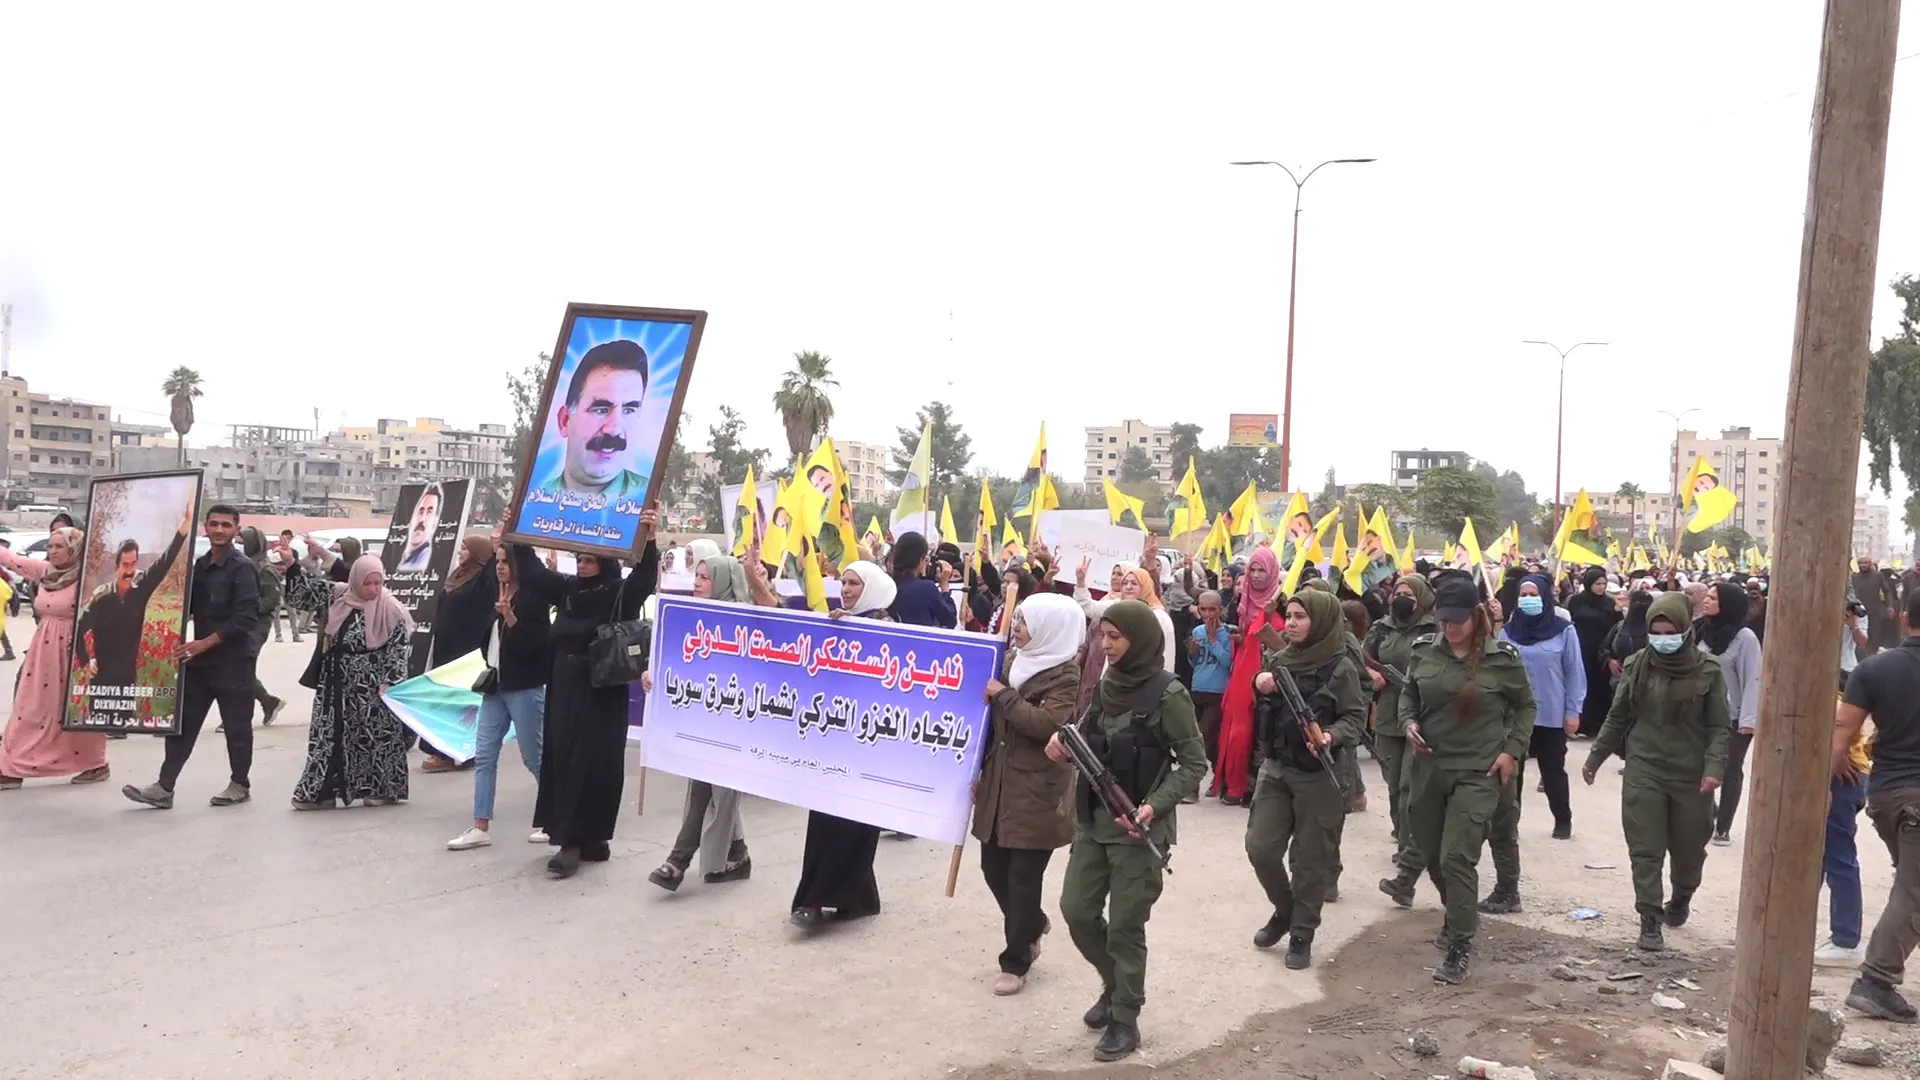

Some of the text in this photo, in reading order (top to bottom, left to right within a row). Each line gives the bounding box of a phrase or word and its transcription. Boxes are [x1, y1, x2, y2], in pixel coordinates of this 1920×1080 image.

[528, 488, 559, 504] السلام
[559, 492, 582, 511] صنع
[583, 494, 605, 512] لمن
[532, 516, 576, 535] الرقاويات
[576, 523, 604, 537] النساء
[682, 619, 963, 698] ندين ونستنكر الصمت الدولي
[85, 685, 121, 696] AZADIYA
[155, 687, 176, 698] APO
[665, 667, 971, 764] باتجاه الغزو التركي لشمال وشرق سوريا
